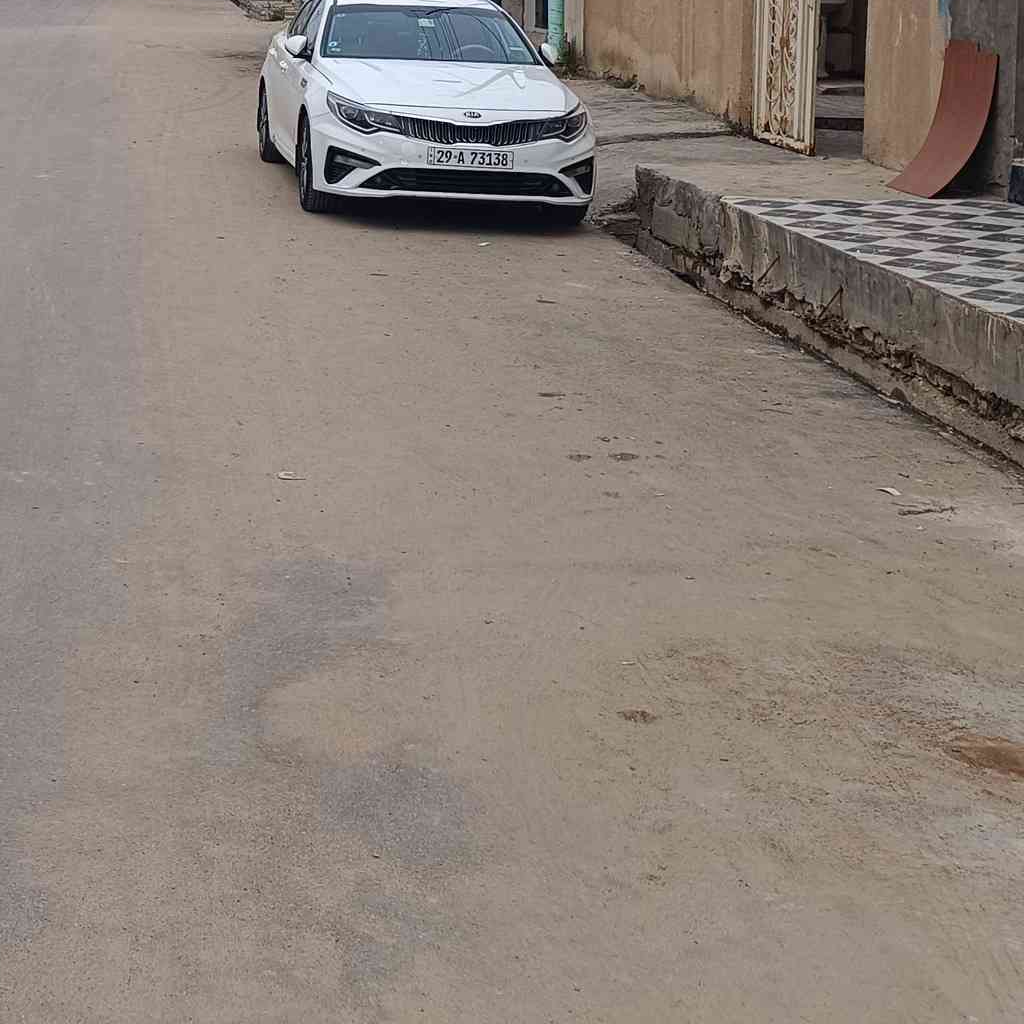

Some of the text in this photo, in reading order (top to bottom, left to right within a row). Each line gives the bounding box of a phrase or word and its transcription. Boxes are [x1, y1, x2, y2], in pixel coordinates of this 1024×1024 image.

[436, 150, 509, 166] 29 A 73138
